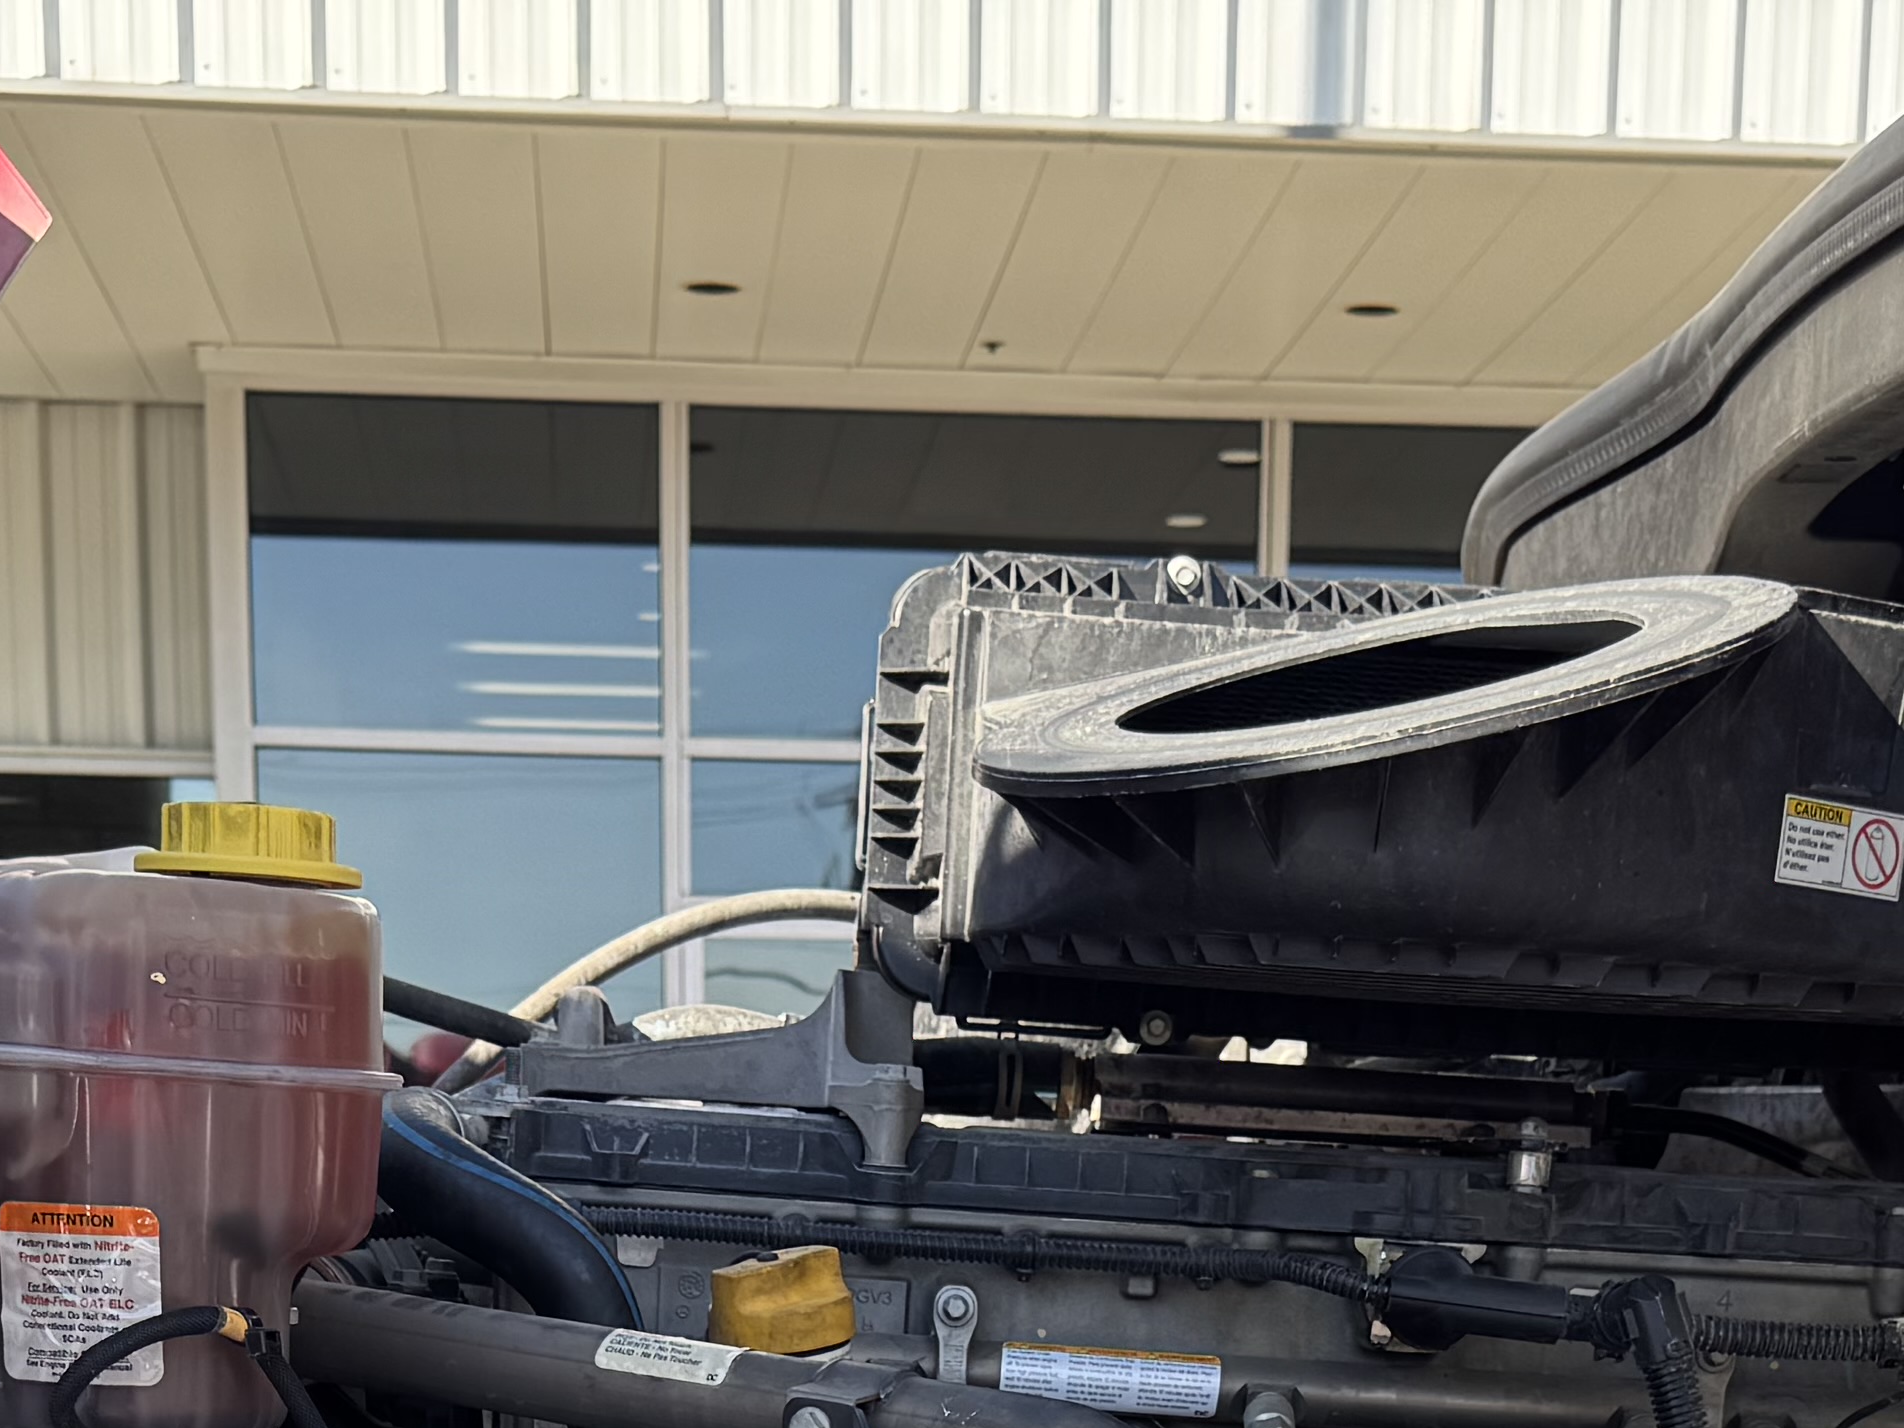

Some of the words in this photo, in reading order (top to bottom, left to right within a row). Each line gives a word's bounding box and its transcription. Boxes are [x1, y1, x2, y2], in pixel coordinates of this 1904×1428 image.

[1794, 802, 1843, 823] CAUTION
[1788, 822, 1797, 832] Do
[31, 1212, 114, 1228] ATTENTION
[17, 1238, 44, 1249] Factory
[47, 1239, 70, 1249] Filled
[72, 1240, 91, 1250] with
[95, 1240, 134, 1252] Nitrite-
[19, 1252, 40, 1264] Free
[43, 1252, 66, 1263] OAT
[69, 1255, 111, 1266] Extended
[114, 1258, 132, 1267] Life
[41, 1267, 75, 1277] Coolant
[81, 1284, 100, 1294] Use
[101, 1285, 124, 1296] Only
[80, 1298, 104, 1310] OAT
[108, 1299, 134, 1310] ELC
[68, 1311, 80, 1320] Do
[82, 1311, 99, 1320] Not
[106, 1362, 133, 1371] anual
[669, 1355, 703, 1366] Toucher
